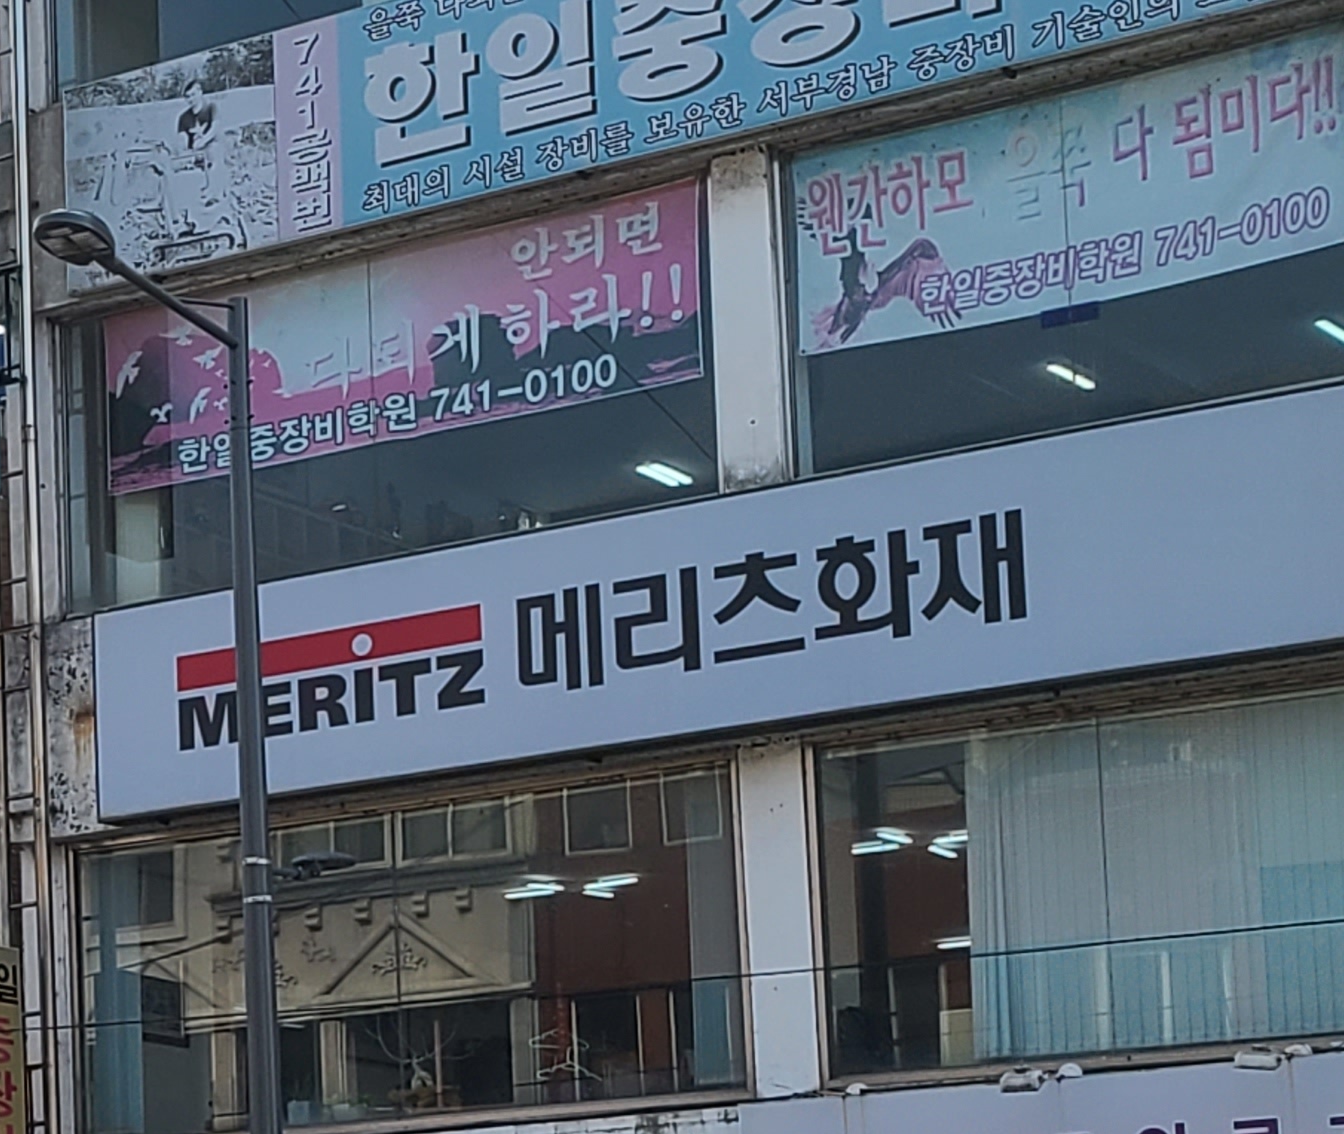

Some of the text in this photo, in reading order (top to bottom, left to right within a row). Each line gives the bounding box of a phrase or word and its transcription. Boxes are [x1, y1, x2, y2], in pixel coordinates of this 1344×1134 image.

[363, 166, 450, 213] 최대의
[464, 146, 525, 189] 시설
[536, 123, 635, 172] 장비를
[644, 94, 746, 145] 보유한
[758, 55, 898, 117] 서부경남
[908, 24, 1014, 82] 중장비
[364, 0, 1002, 164] 한일중
[512, 201, 664, 281] 안되면
[919, 184, 1331, 317] 한일중장비학원 741-0100
[430, 352, 618, 421] 741-0100
[517, 508, 1028, 691] 메리츠화재
[178, 649, 486, 752] MERITZ
